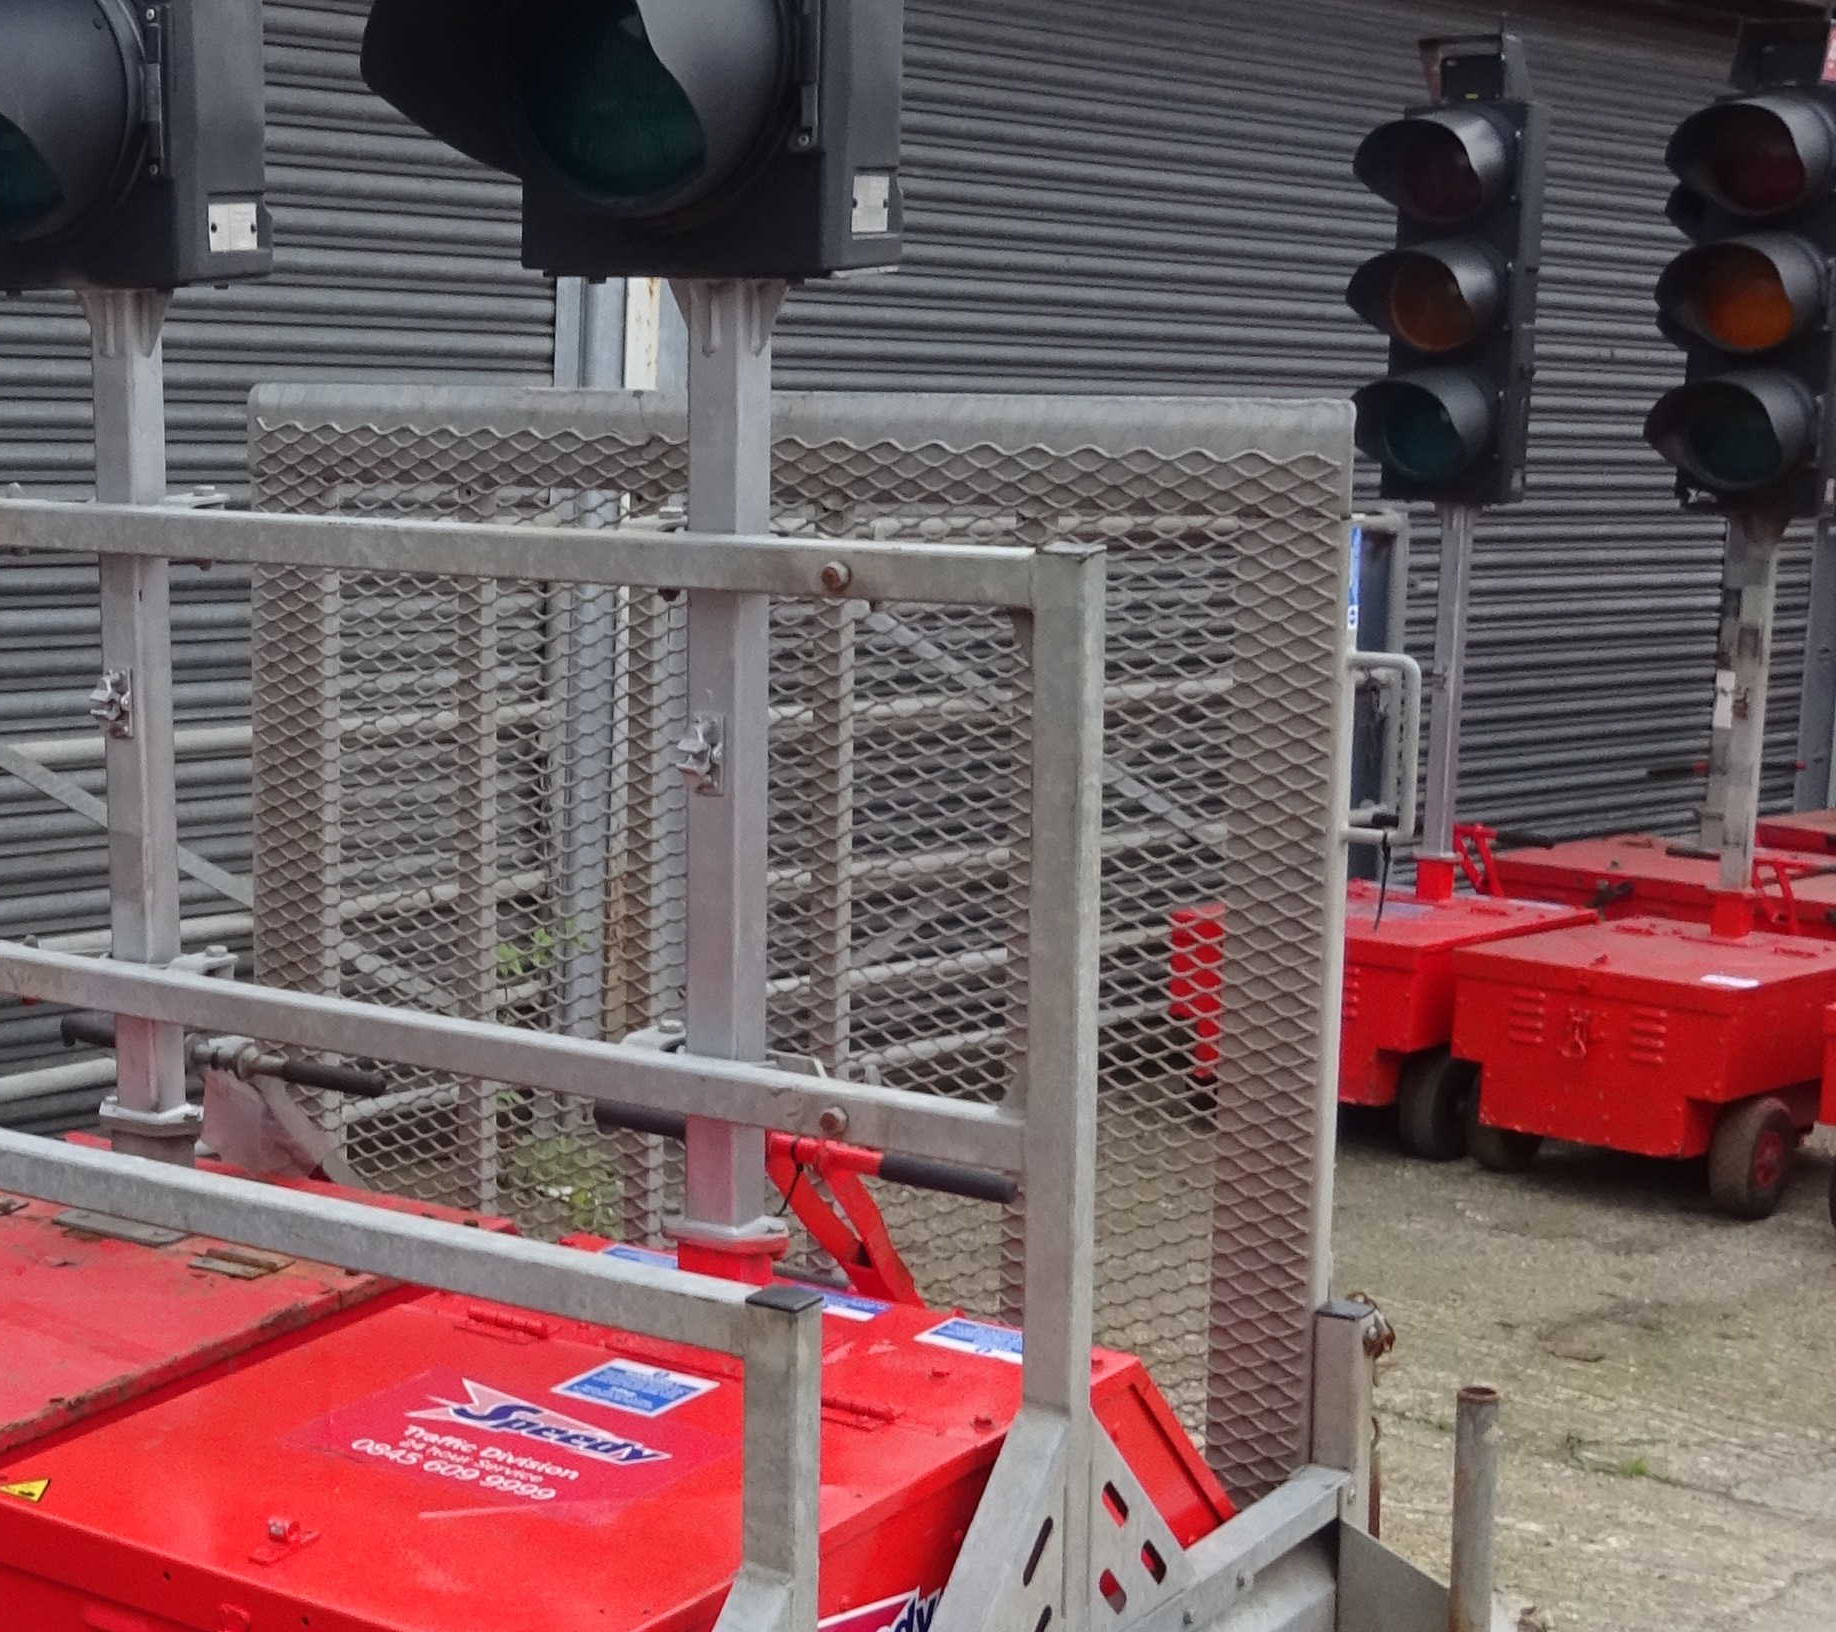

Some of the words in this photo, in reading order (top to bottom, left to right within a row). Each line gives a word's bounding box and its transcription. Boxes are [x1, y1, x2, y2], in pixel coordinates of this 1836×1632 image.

[404, 1424, 478, 1454] Traffic
[479, 1446, 580, 1481] Division
[450, 1403, 661, 1462] Speedy
[351, 1438, 424, 1465] 0845
[423, 1459, 481, 1481] 609
[479, 1474, 557, 1500] 9999
